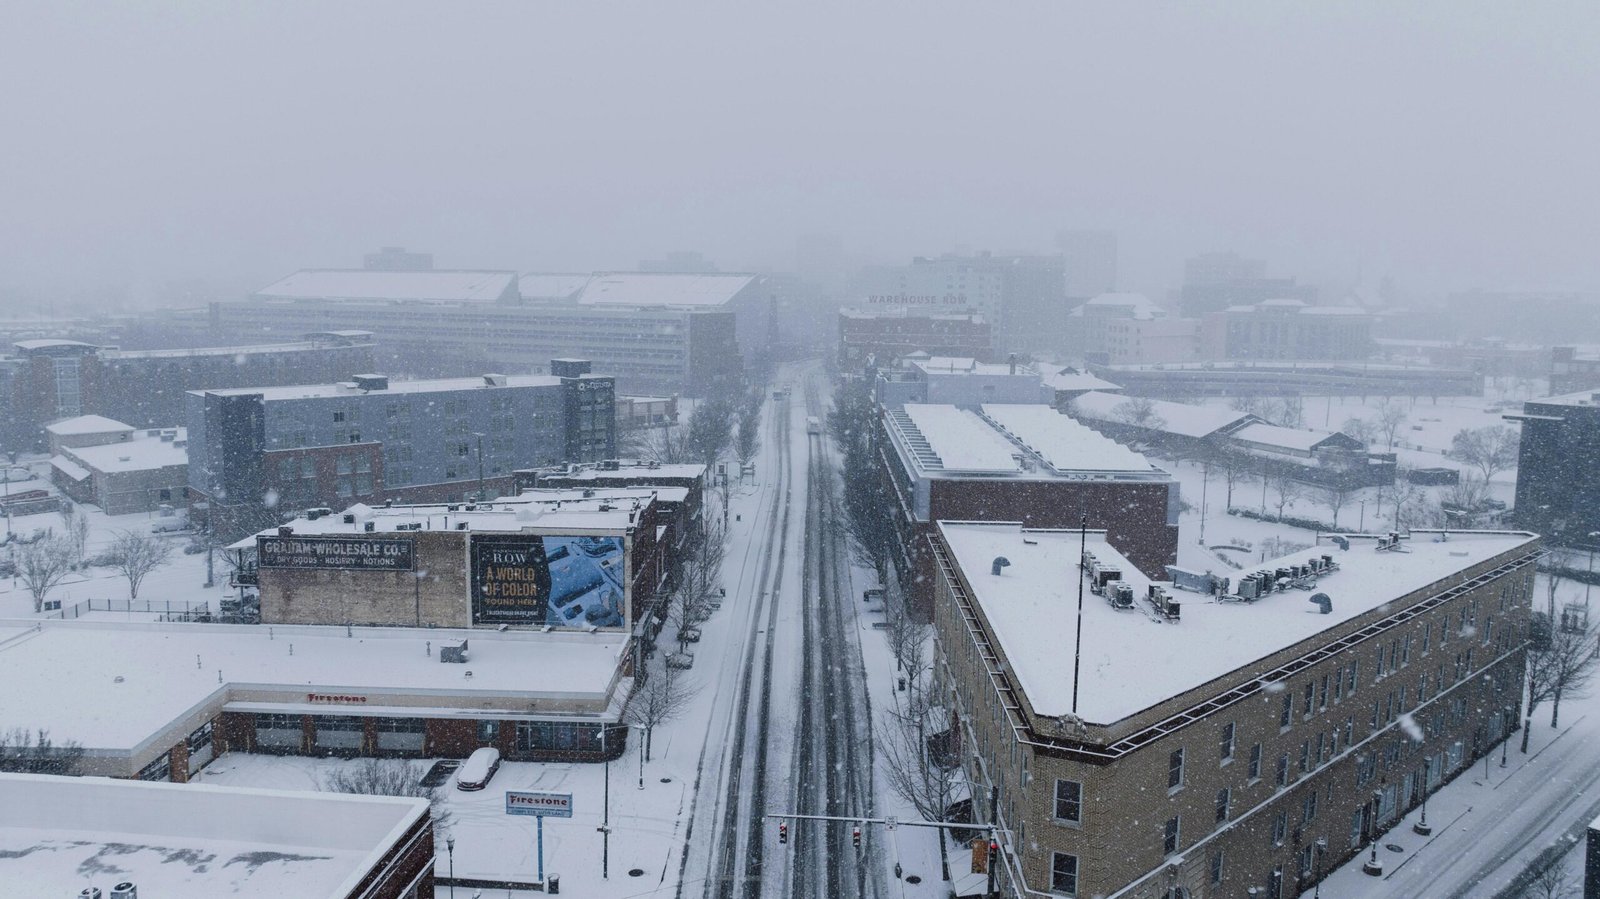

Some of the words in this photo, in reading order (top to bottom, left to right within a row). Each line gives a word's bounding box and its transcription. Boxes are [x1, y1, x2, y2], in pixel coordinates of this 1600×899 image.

[868, 295, 937, 304] WAREHOUSE
[943, 295, 968, 305] ROW
[316, 543, 380, 556] WHOLESALE
[293, 556, 318, 564] GOODS
[363, 557, 395, 566] NOTIONS
[493, 553, 526, 563] ROW
[486, 566, 494, 581] A
[496, 567, 535, 582] WORLD
[486, 582, 500, 596] OF
[502, 582, 537, 596] COLOR
[307, 693, 367, 703] Firestone
[509, 795, 568, 806] Firestone
